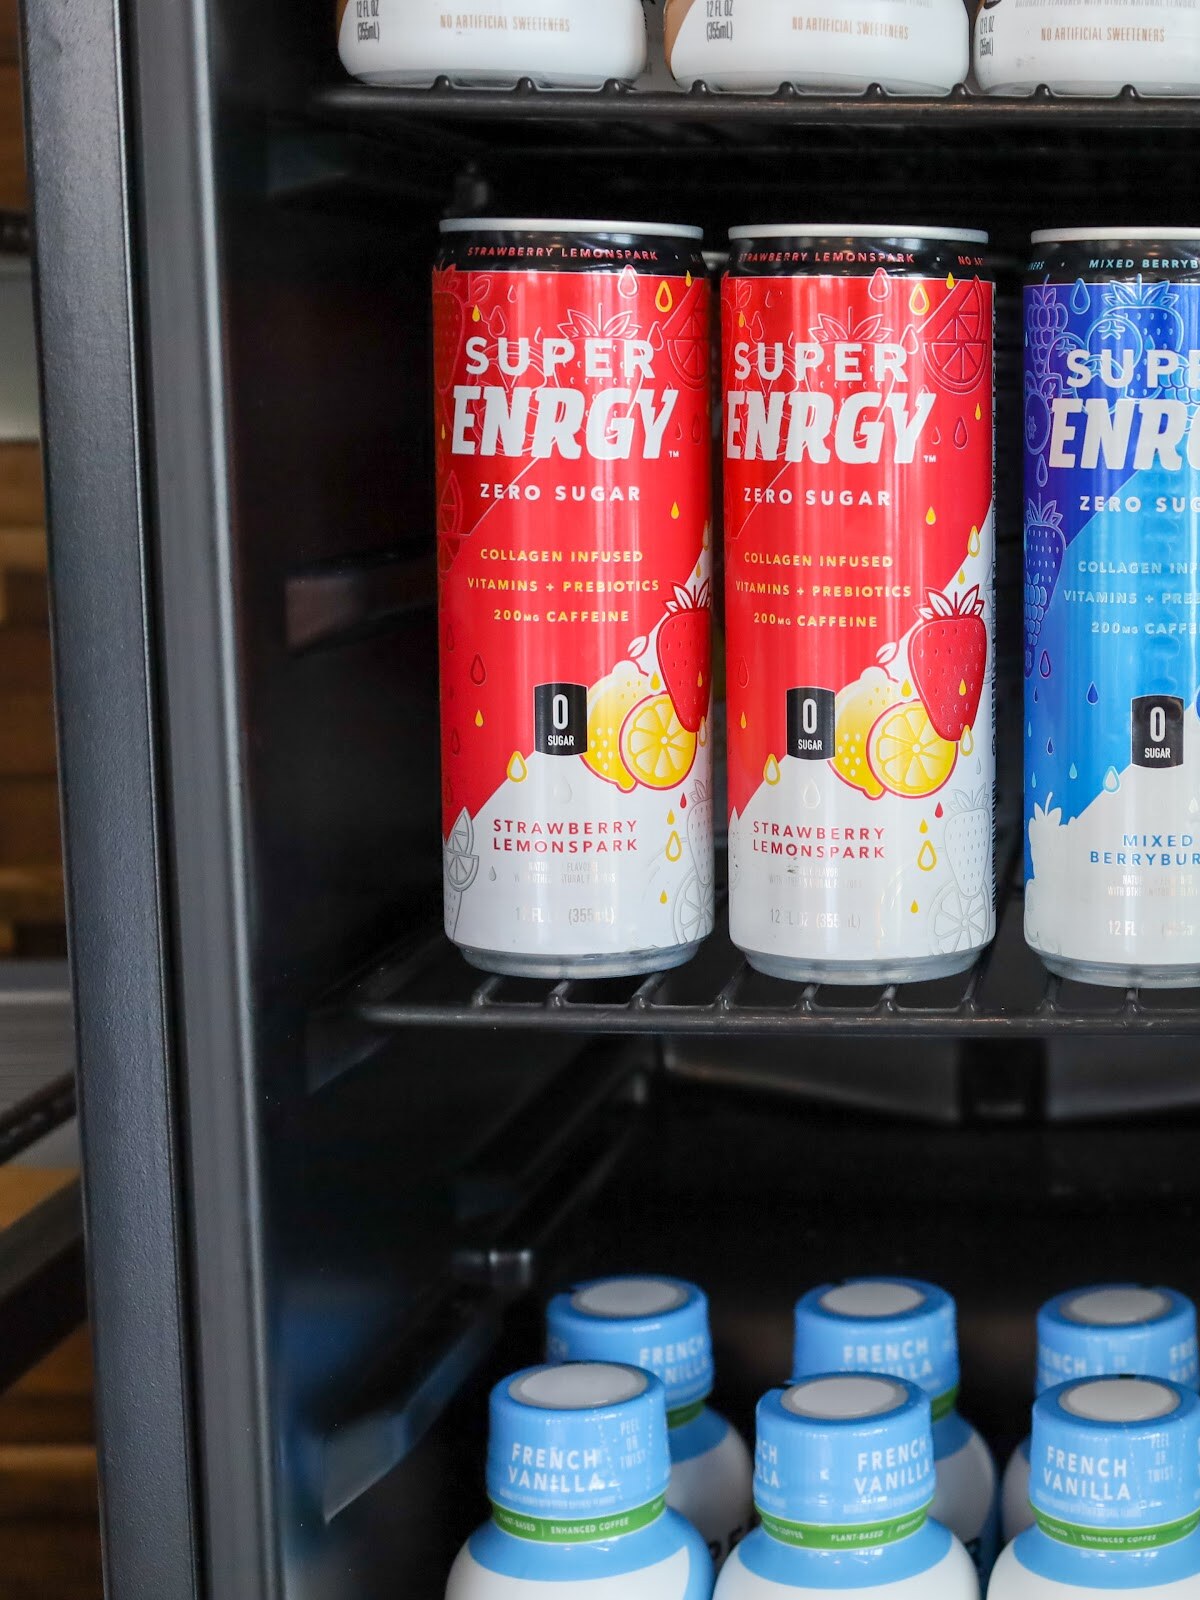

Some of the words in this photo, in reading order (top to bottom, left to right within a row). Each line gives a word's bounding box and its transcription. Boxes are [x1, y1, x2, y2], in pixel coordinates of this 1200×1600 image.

[440, 14, 452, 28] NO
[456, 14, 508, 30] ARTIFICIAL
[512, 16, 570, 32] SWEETENERS
[792, 17, 803, 31] NO
[806, 17, 853, 34] ARTIFICIAL
[1041, 27, 1052, 41] NO
[1054, 27, 1101, 41] ARTIFICIAL
[1106, 27, 1165, 42] SWEETENERS
[467, 246, 553, 258] STRAWBERRY
[561, 247, 658, 261] LEMONSPARK
[814, 252, 915, 263] LEMONSPARK
[1089, 259, 1135, 270] MIXED
[465, 336, 655, 378] SUPER
[734, 342, 908, 382] SUPER
[452, 385, 679, 460] ENRGY
[726, 390, 936, 464] ENRGY
[480, 484, 541, 500] ZERO
[555, 485, 640, 502] SUGAR
[744, 487, 793, 504] ZERO
[805, 489, 891, 506] SUGAR
[1080, 496, 1141, 512] ZERO
[480, 548, 563, 562] COLLAGEN
[570, 550, 643, 563] INFUSED
[744, 551, 813, 567] COLLAGEN
[819, 554, 893, 568] INFUSED
[1078, 561, 1162, 575] COLLAGEN
[468, 577, 538, 592] VITAMINS
[562, 579, 660, 592] PREBIOTICS
[735, 580, 790, 596] VITAMINS
[812, 585, 911, 598] PREBIOTICS
[1063, 589, 1137, 604] VITAMINS
[546, 609, 630, 623] CAFFEINE
[797, 614, 878, 628] CAFFEINE
[552, 694, 569, 729] 0
[802, 698, 818, 734] 0
[1149, 706, 1166, 742] 0
[547, 735, 575, 747] SUGAR
[798, 739, 823, 751] SUGAR
[1144, 747, 1171, 759] SUGAR
[493, 818, 638, 835] STRAWBERRY
[753, 821, 885, 840] STRAWBERRY
[493, 837, 638, 853] LEMONSPARK
[753, 839, 885, 858] LEMONSPARK
[1123, 834, 1194, 848] MIXED
[843, 1337, 929, 1363] FRENCH
[512, 1442, 599, 1470] FRENCH
[857, 1435, 928, 1472] FRENCH
[1046, 1446, 1128, 1478] FRENCH
[508, 1465, 606, 1493] VANILLA
[853, 1459, 930, 1495] VANILLA
[1043, 1467, 1131, 1501] VANILLA
[551, 1525, 596, 1535] ENHANCED
[599, 1517, 629, 1532] COFFEE
